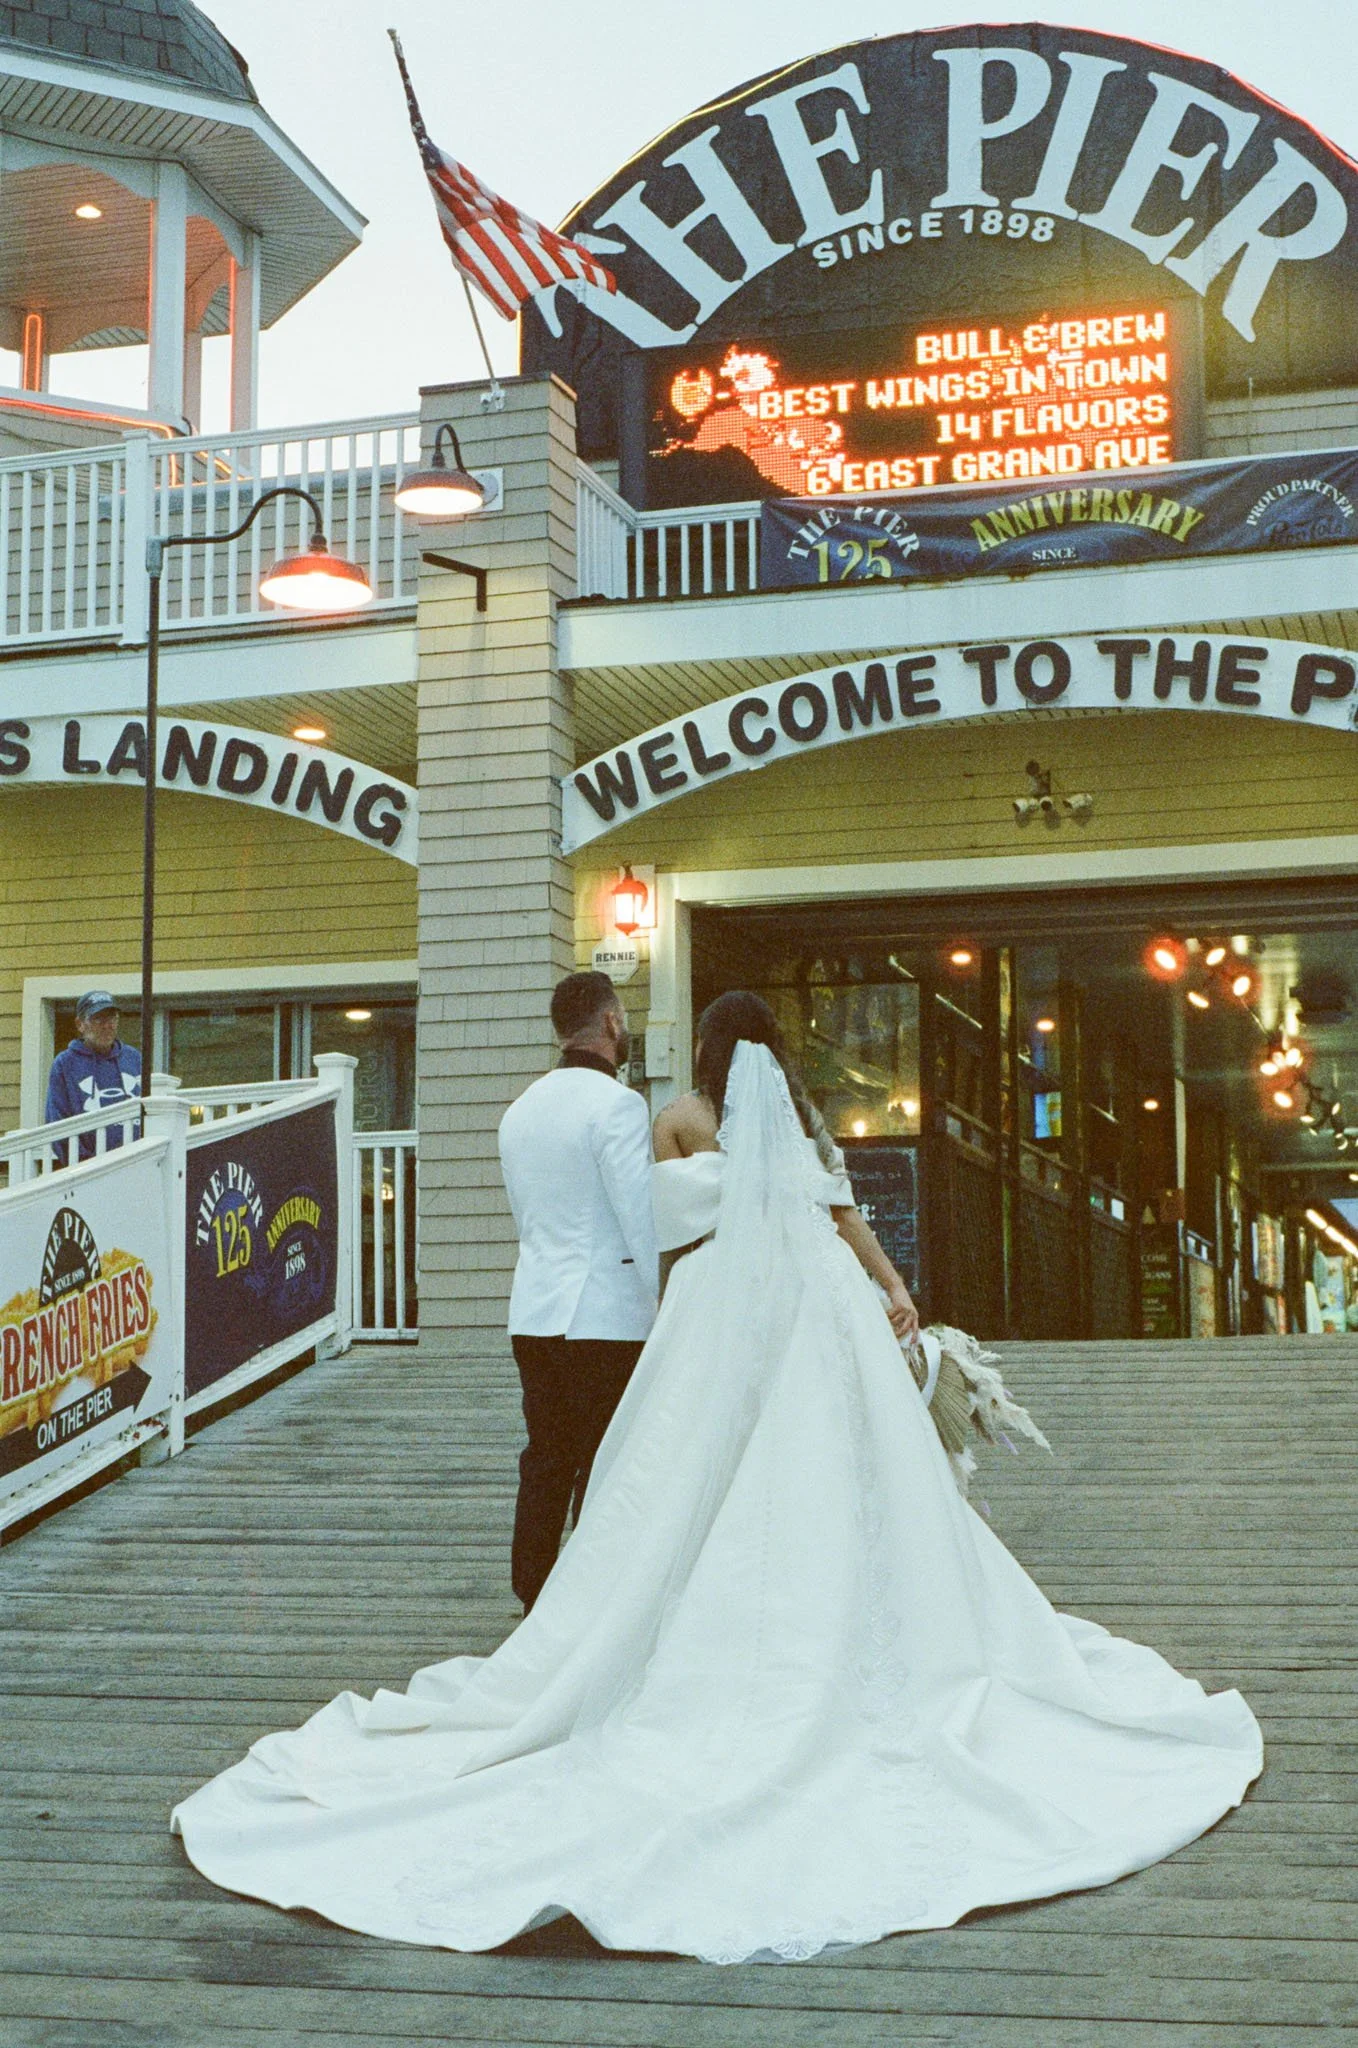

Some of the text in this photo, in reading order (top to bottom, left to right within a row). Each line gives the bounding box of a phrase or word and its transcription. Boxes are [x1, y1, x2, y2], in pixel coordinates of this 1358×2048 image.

[533, 47, 1348, 348] THE PIER
[811, 208, 1056, 268] SINCE 1898
[915, 312, 1166, 365] BULL & BREW
[759, 353, 1168, 420] BEST WINGS IN TOWN
[937, 394, 1168, 443] 14 FLAVORS
[842, 456, 941, 492] EAST
[952, 442, 1083, 482] GRAND
[1095, 434, 1170, 470] AVE
[970, 487, 1205, 552] ANNIVERSARY
[1245, 478, 1355, 526] PROUD PARTNER
[787, 505, 920, 561] THE PIER
[812, 537, 893, 582] 125
[1031, 546, 1077, 561] SINCE
[574, 638, 1358, 821] WELCOME TO THE P
[62, 719, 408, 848] LANDING
[595, 951, 636, 963] RENNIE
[195, 1161, 263, 1248] THE PIER
[266, 1195, 322, 1253] ANNIVERSARY
[42, 1212, 101, 1305] THE PIER
[212, 1204, 251, 1278] 125
[285, 1252, 307, 1281] 1898
[287, 1240, 303, 1257] SINCE
[0, 1265, 150, 1401] RENCH FRIES
[37, 1386, 114, 1450] ON THE PIER
